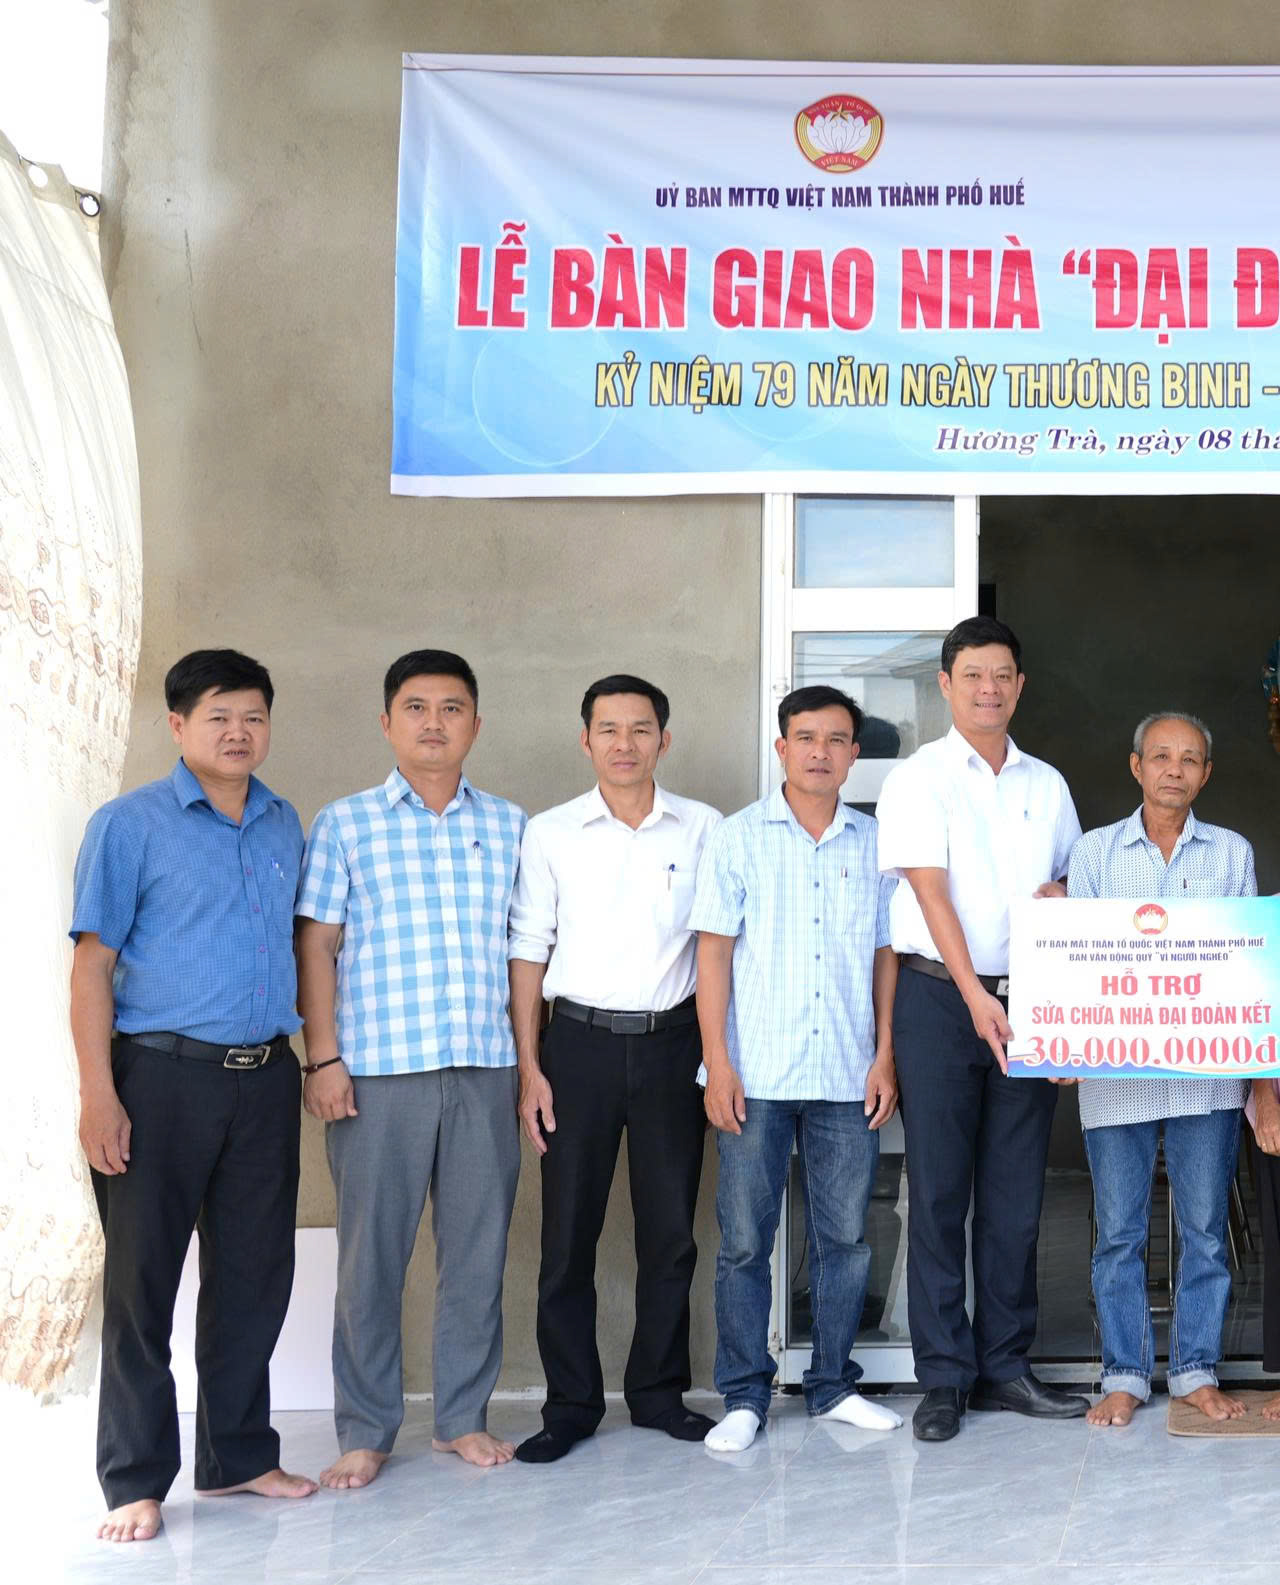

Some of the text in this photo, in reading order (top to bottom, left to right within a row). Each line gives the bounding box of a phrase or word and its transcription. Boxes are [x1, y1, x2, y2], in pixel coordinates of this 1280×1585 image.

[656, 177, 1025, 211] UỶ BAN MTTQ VIỆT NAM THÀNH PHỐ HUẾ
[458, 222, 527, 328] LỄ
[551, 234, 687, 329] BÀN
[713, 247, 874, 331] GIAO
[901, 235, 1040, 329] NHÀ
[1063, 248, 1208, 344] “ĐẠI
[595, 351, 641, 407] KỶ
[650, 355, 743, 413] NIỆM
[753, 361, 796, 408] 79
[808, 355, 889, 407] NĂM
[901, 356, 997, 408] NGÀY
[1004, 359, 1150, 409] THƯƠNG
[1162, 362, 1251, 408] BINH
[935, 427, 1039, 455] Hương
[1048, 428, 1107, 454] Trà,
[1116, 429, 1190, 455] ngày
[1198, 429, 1232, 449] 08
[1050, 940, 1068, 948] BAN
[1175, 940, 1195, 948] NAM
[1069, 953, 1087, 961] BAN
[1101, 967, 1202, 1000] HỖ TRỢ
[1032, 1000, 1271, 1029] SỬA CHỮA NHÀ ĐẠI ĐOÀN KẾT
[1025, 1035, 1277, 1065] 30.000.0000đ
